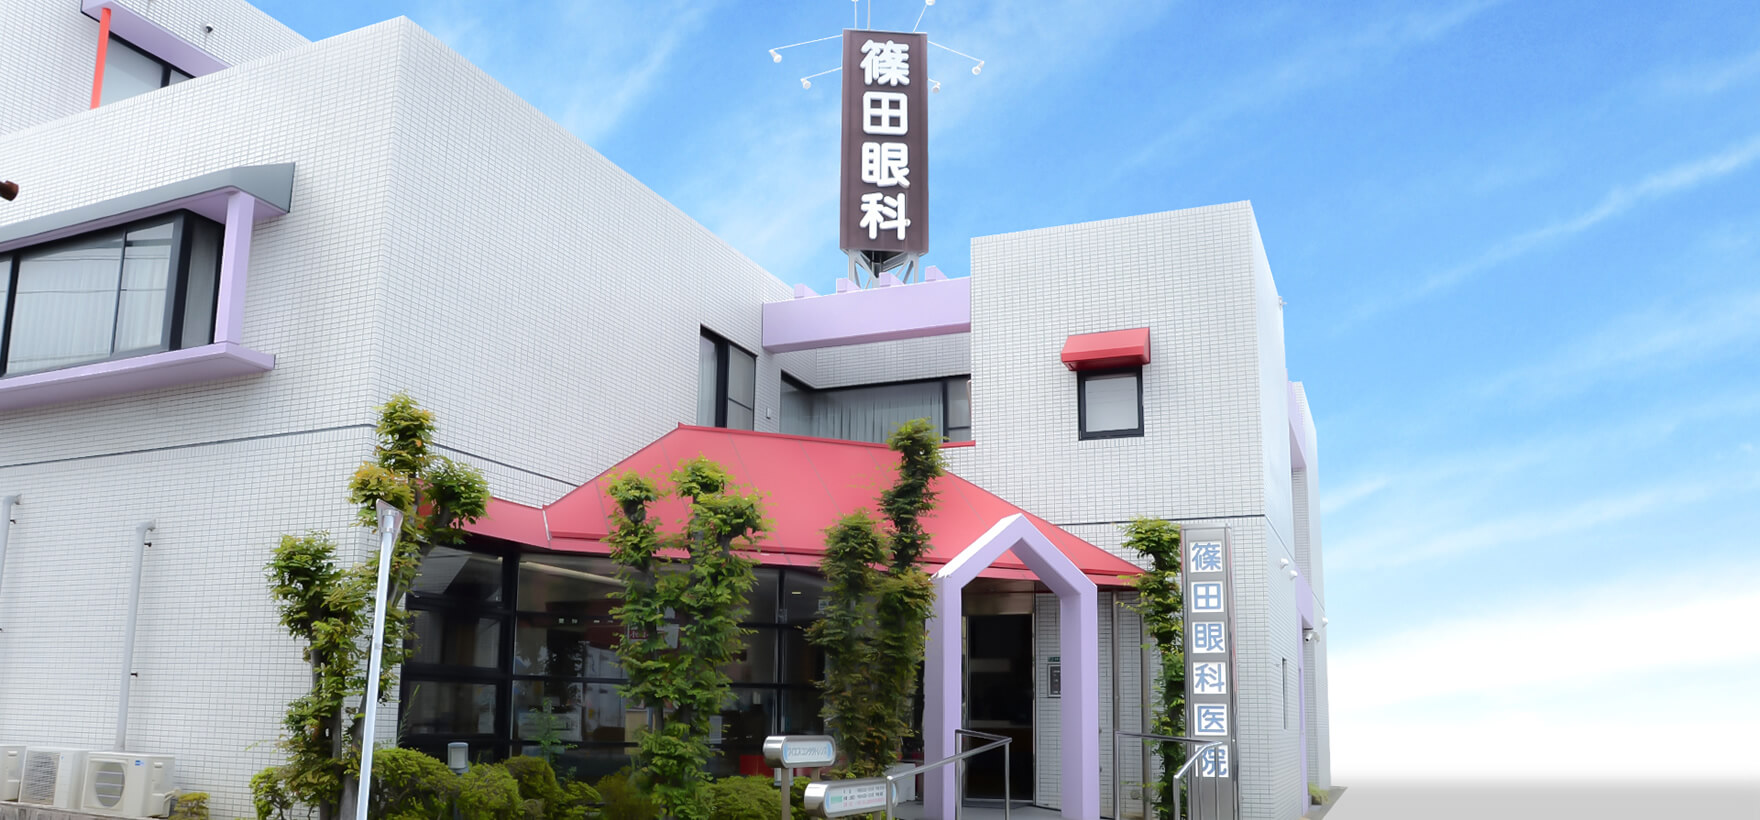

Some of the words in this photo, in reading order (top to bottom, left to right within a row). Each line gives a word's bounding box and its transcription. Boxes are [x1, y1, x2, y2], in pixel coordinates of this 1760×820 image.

[859, 39, 911, 240] 篠田眼科
[1191, 542, 1227, 776] 篠田眼科医院
